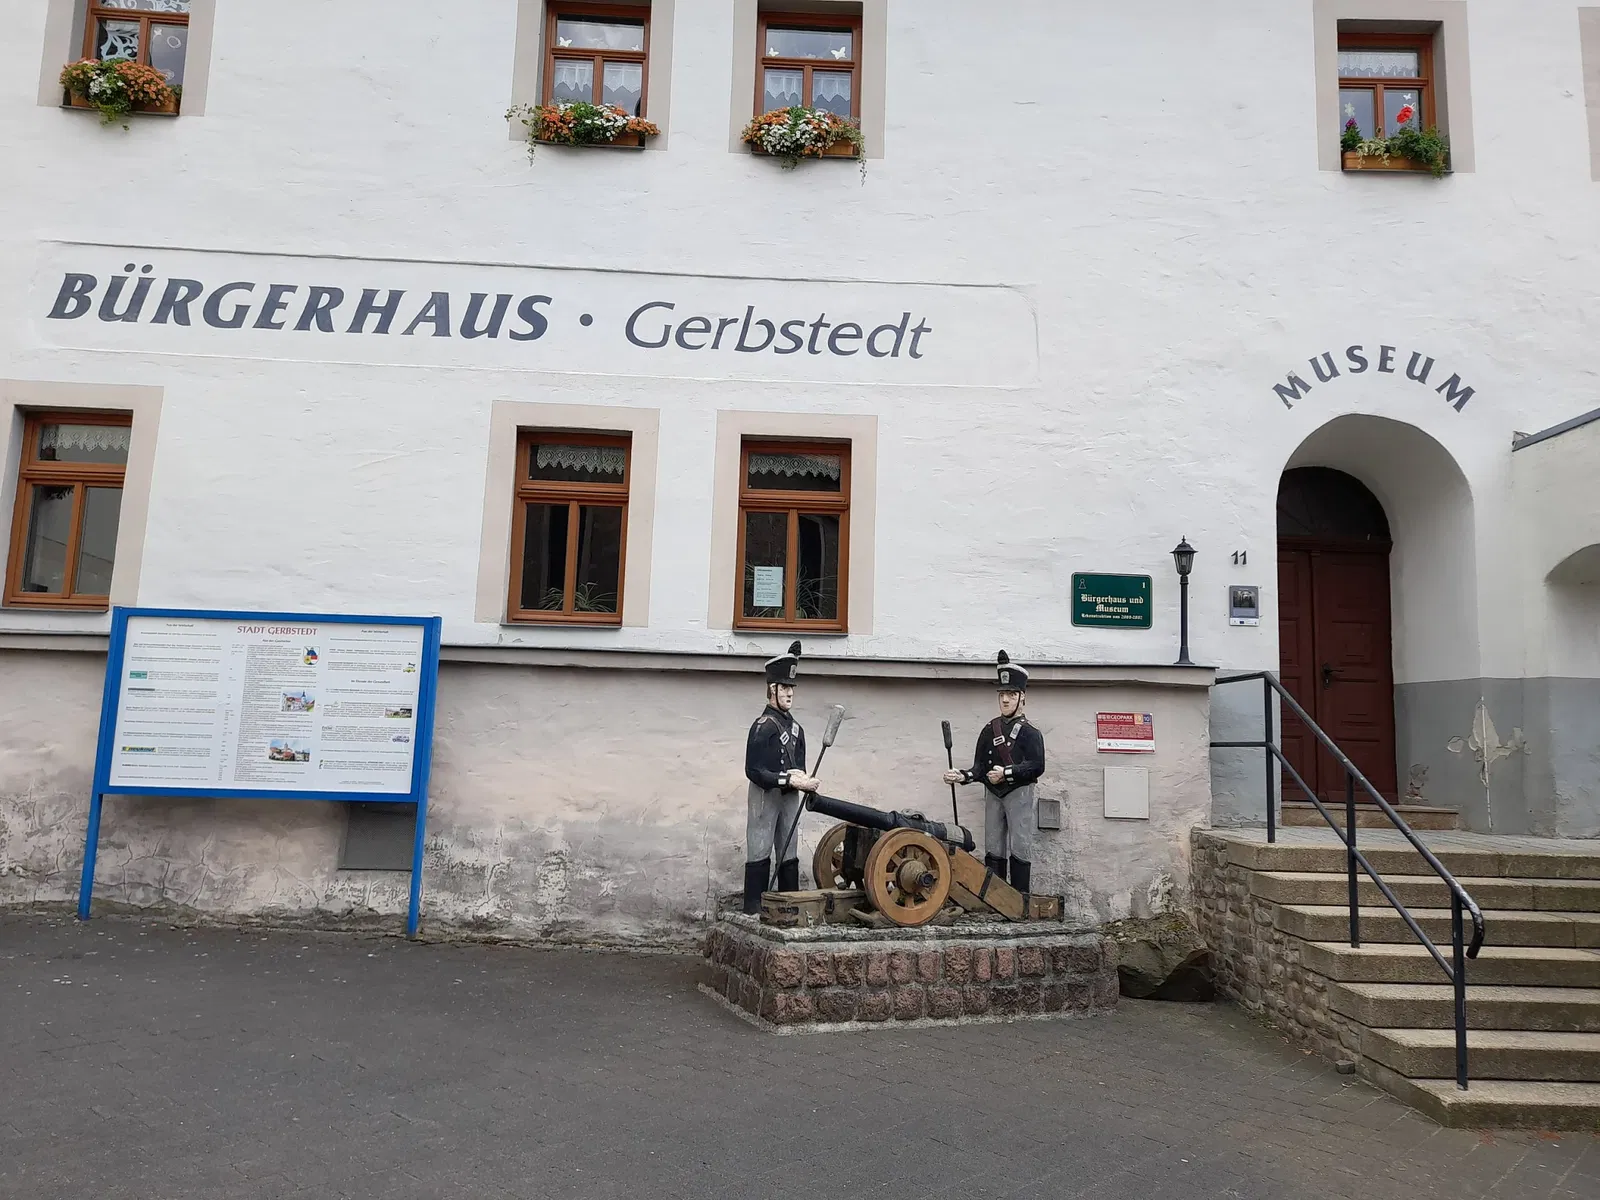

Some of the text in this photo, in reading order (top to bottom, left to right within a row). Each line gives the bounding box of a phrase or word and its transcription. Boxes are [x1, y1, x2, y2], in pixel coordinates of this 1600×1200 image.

[45, 262, 933, 359] BÜRGERHAUS Gerbstedt
[1272, 345, 1476, 413] MUSEUM
[1231, 550, 1247, 565] 11
[1080, 593, 1144, 604] Bürgerhaus und
[1095, 604, 1129, 613] Museum
[237, 626, 318, 636] STADT GERBSTEDT
